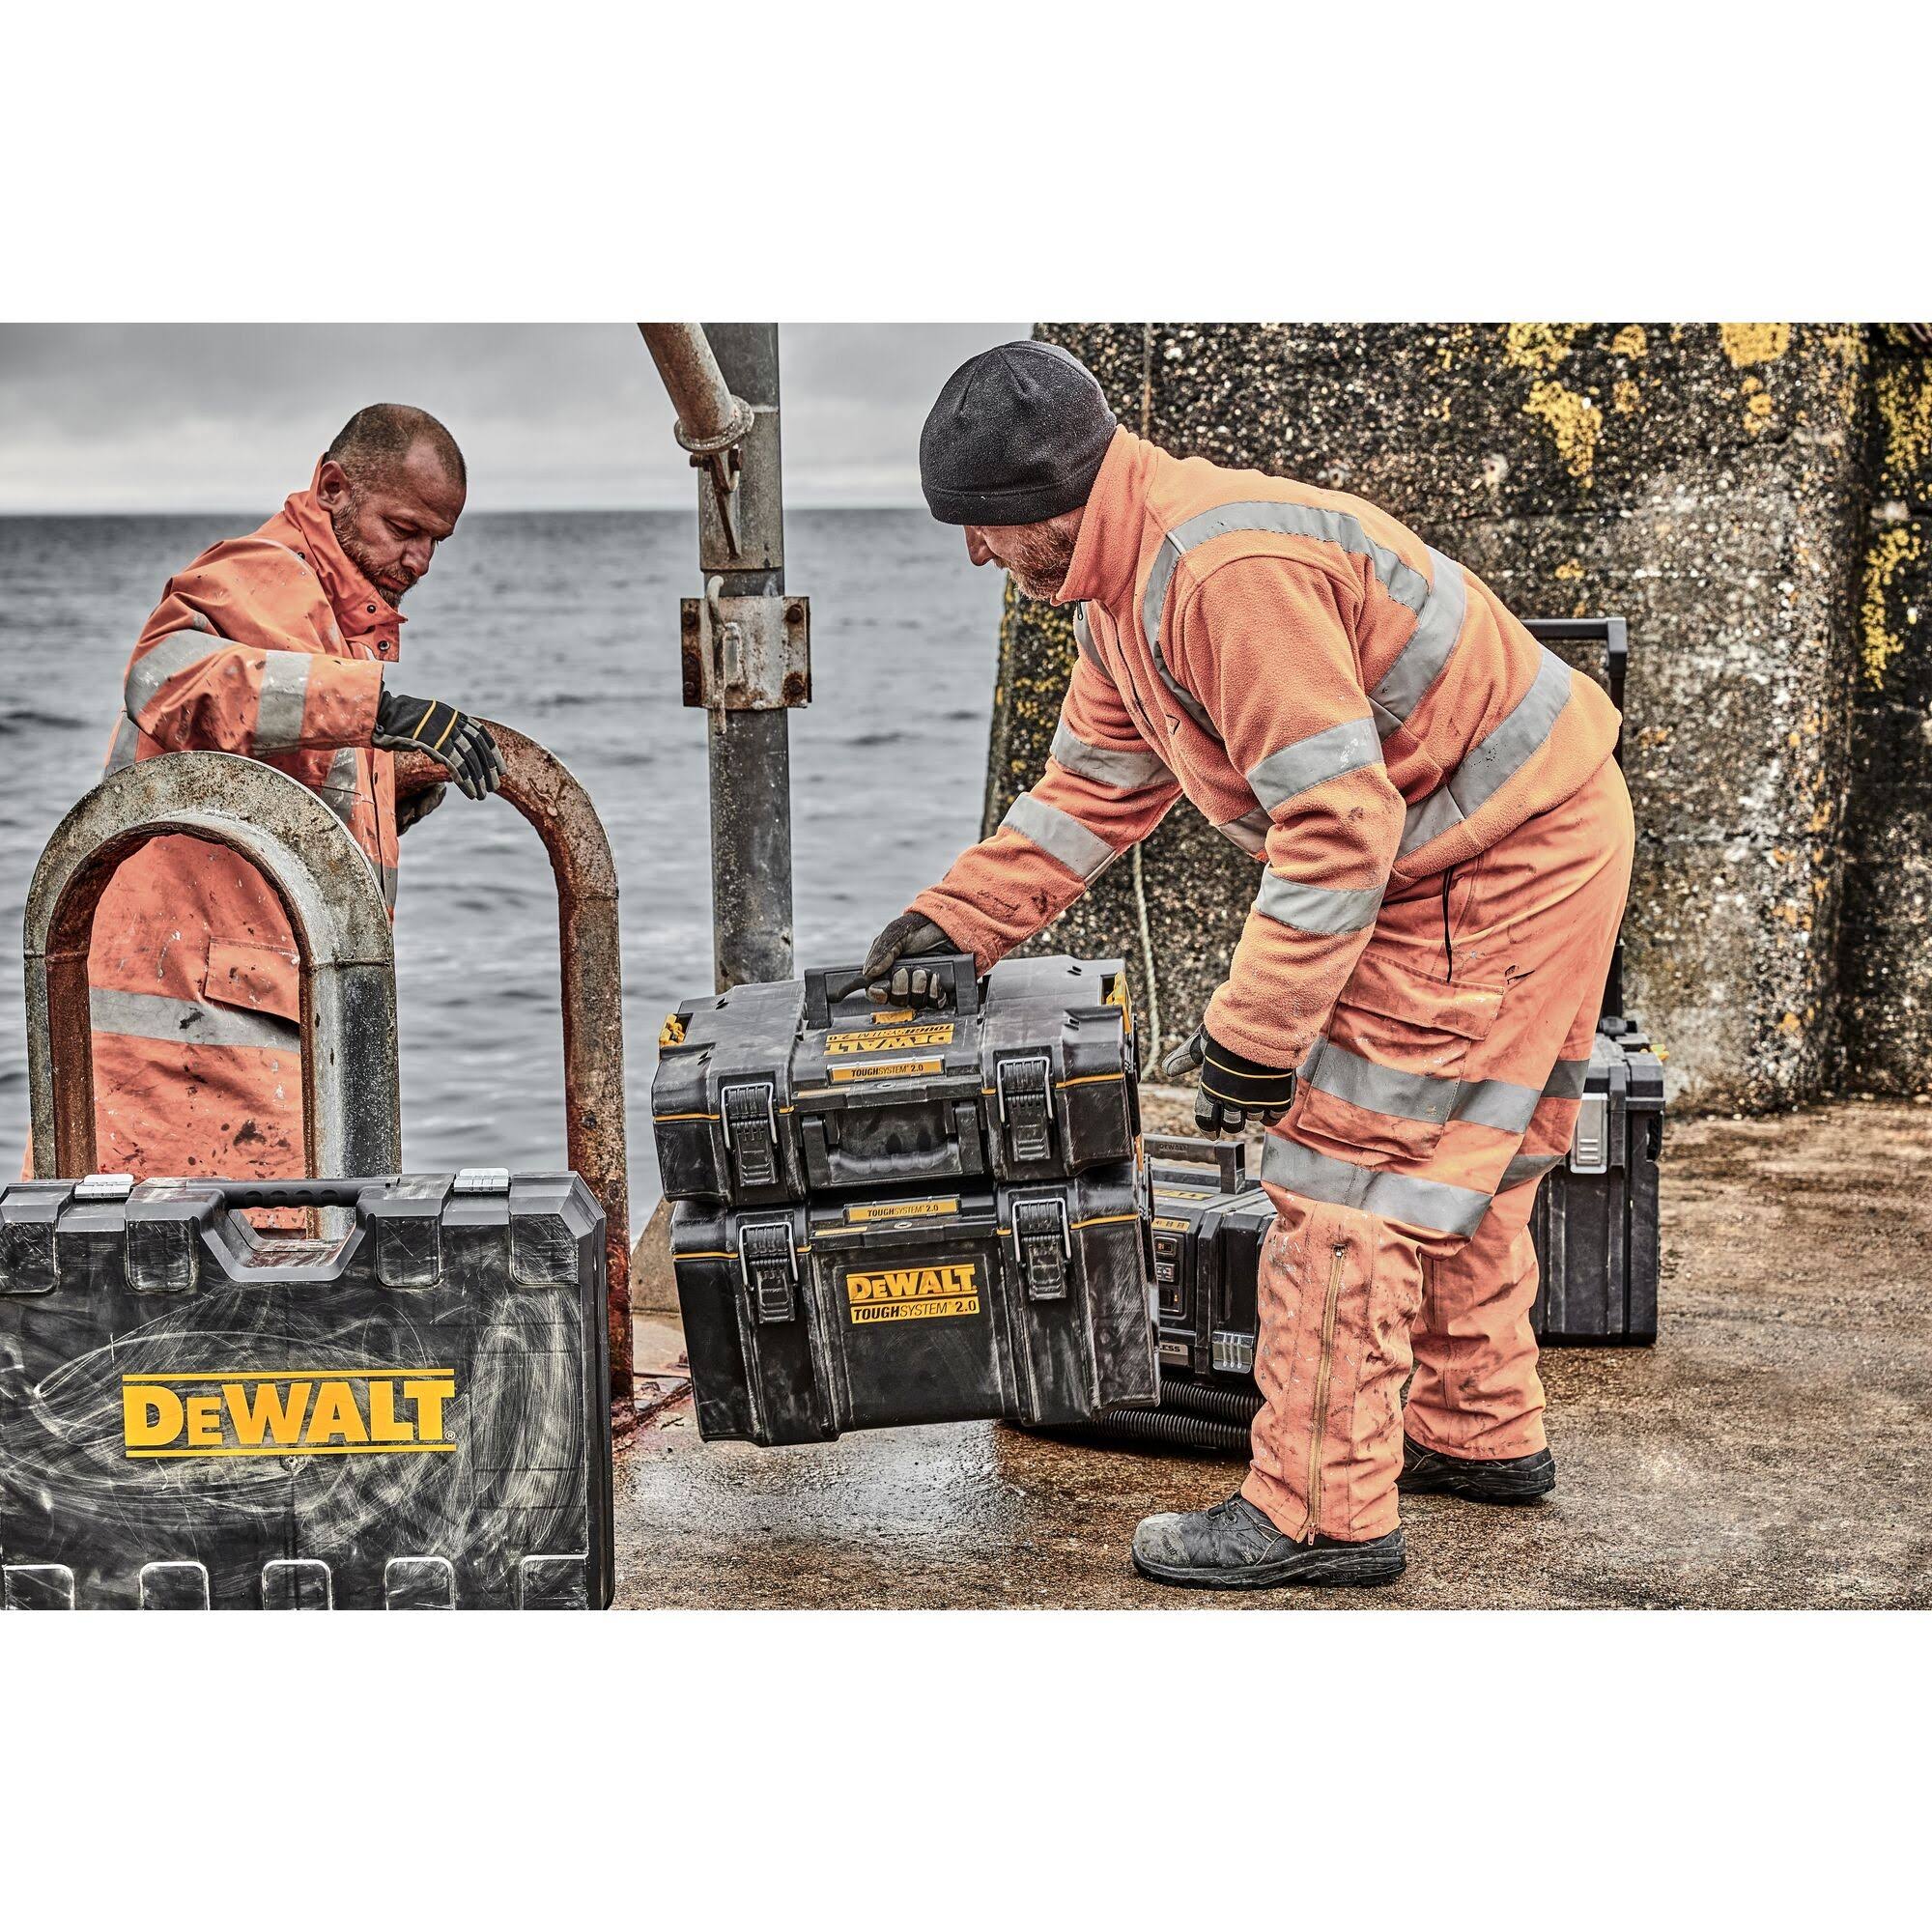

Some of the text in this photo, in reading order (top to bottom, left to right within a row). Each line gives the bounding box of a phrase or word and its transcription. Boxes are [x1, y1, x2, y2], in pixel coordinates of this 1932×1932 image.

[851, 1064, 923, 1077] TOUGHSYSTEM 2.0
[867, 1204, 939, 1217] TOUGHSYSTEM 2.0
[846, 1266, 976, 1300] DEWALT
[854, 1299, 977, 1321] TOUGHSYSTEM 2.0
[122, 1379, 455, 1447] DEWALT
